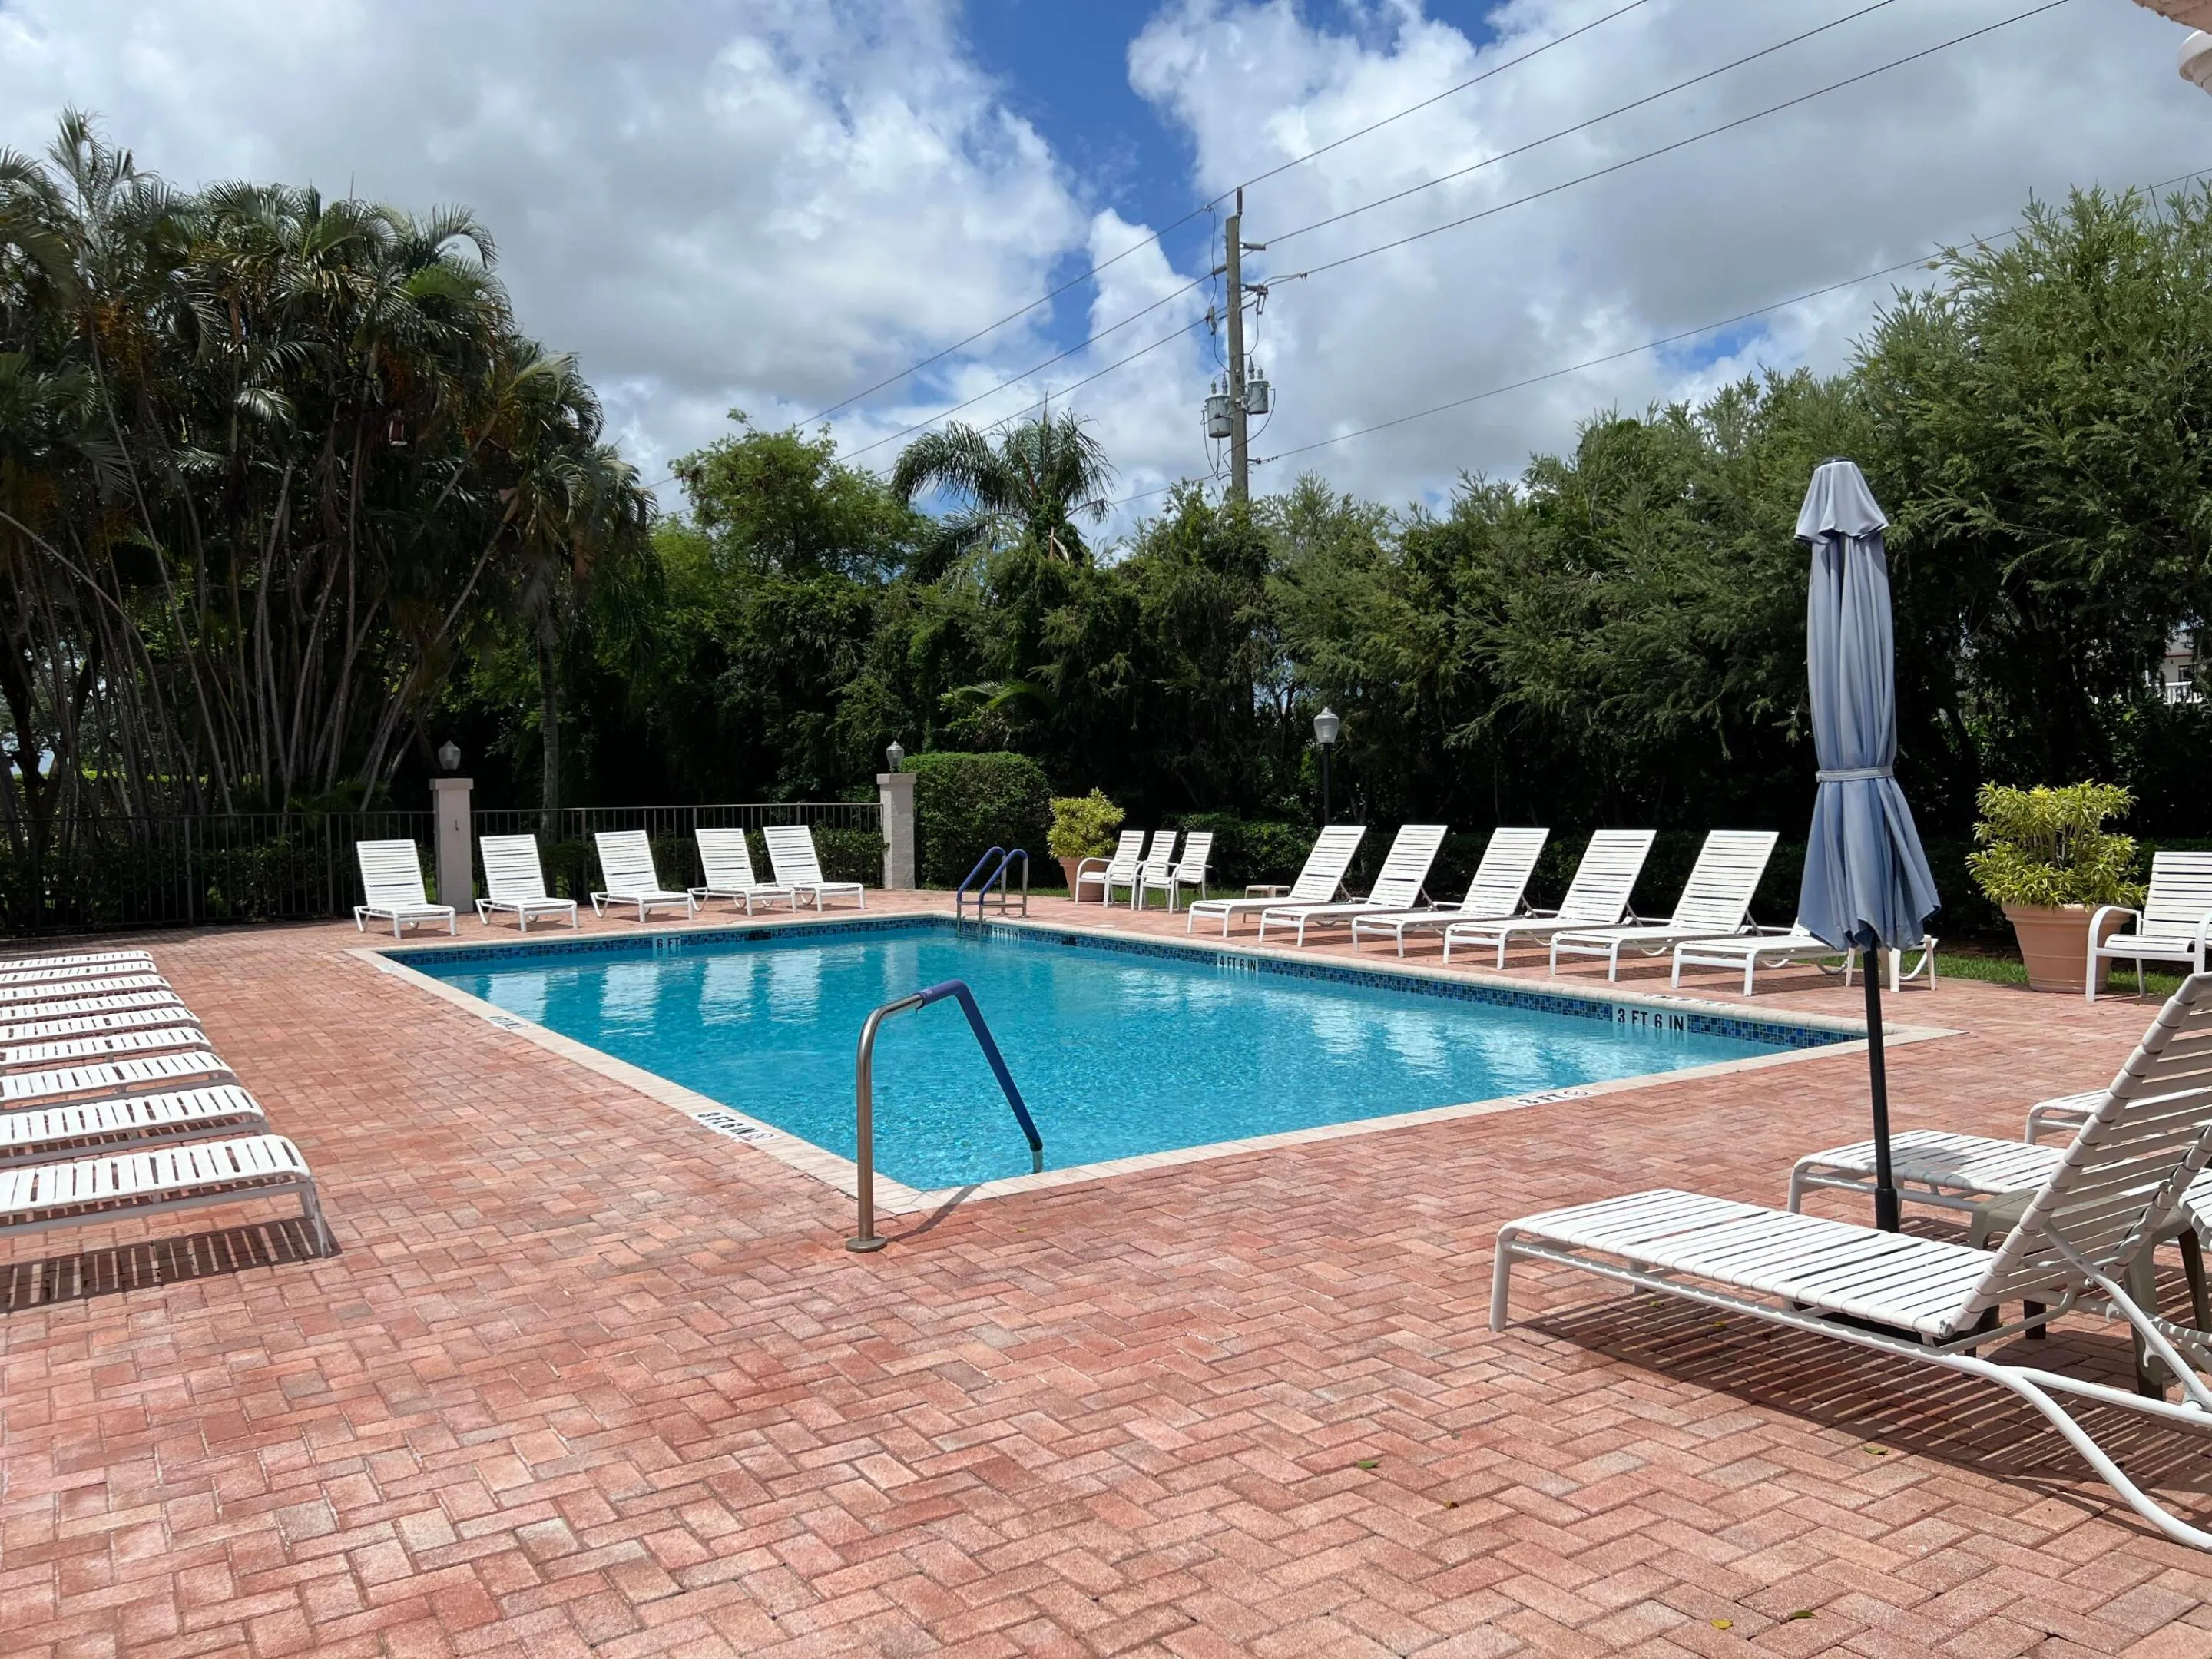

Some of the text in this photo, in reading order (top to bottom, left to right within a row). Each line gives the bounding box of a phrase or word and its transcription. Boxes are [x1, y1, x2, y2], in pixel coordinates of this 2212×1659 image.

[657, 937, 680, 949] 6 FT
[1220, 955, 1257, 971] 4 FT 6 IN
[1618, 1008, 1625, 1023] 3
[1654, 1013, 1663, 1028] 6
[1669, 1015, 1684, 1031] IN
[705, 1116, 736, 1124] FT
[729, 1126, 760, 1135] IN
